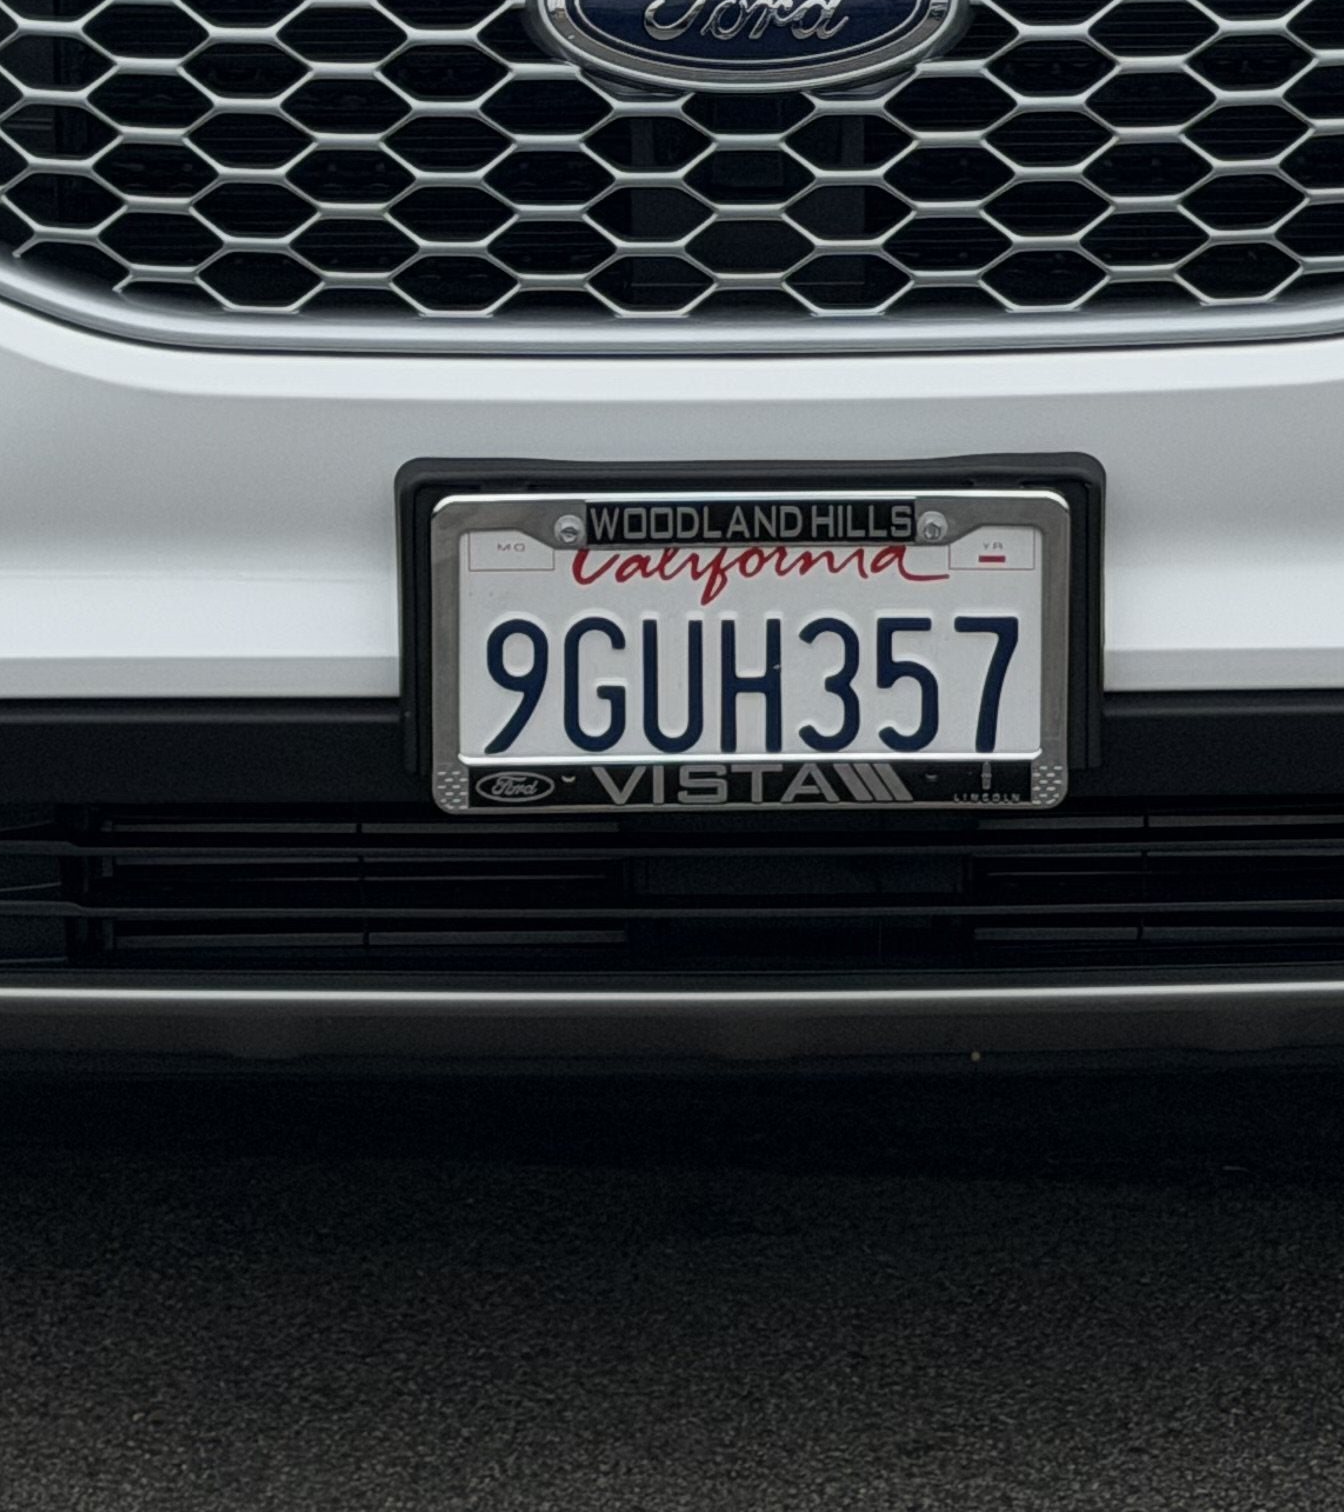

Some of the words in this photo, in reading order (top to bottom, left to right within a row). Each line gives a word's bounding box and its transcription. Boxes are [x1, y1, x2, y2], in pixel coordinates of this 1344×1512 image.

[589, 504, 803, 541] WOODLAND
[811, 504, 912, 539] HILLS
[484, 615, 1019, 754] 9GUH357
[491, 776, 538, 796] Ford
[592, 763, 840, 805] VISTA
[953, 792, 1021, 803] LINCOLN
